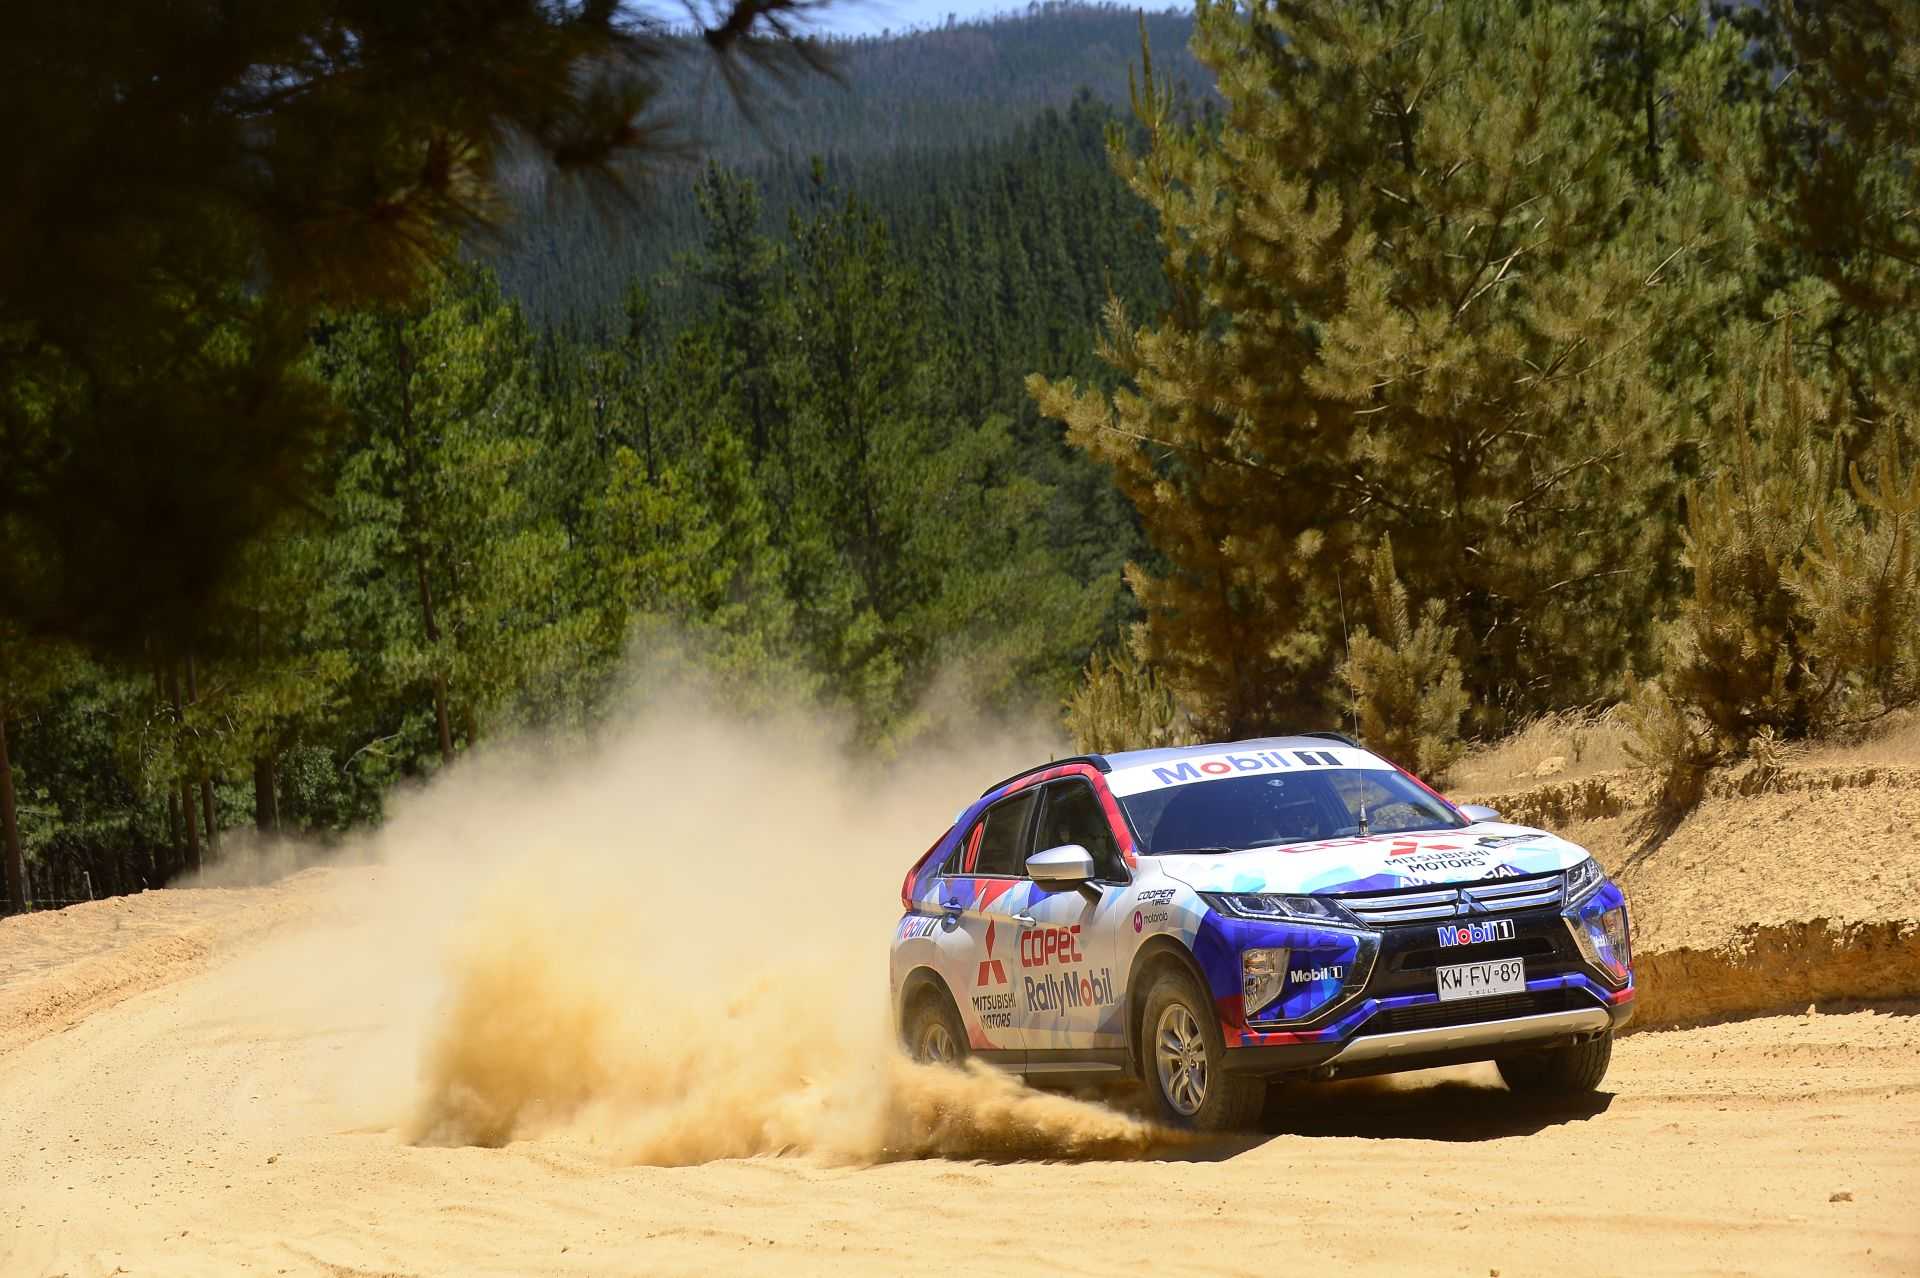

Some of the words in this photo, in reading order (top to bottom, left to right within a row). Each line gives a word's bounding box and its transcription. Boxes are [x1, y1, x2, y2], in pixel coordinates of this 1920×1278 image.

[1152, 752, 1291, 784] Mobil
[1384, 849, 1491, 867] MITSUBISHI
[1407, 857, 1487, 873] MOTORS
[1137, 888, 1177, 901] COOPER
[1437, 923, 1496, 948] Mobil
[1021, 924, 1083, 968] COPEC
[1290, 967, 1328, 983] Mobil
[971, 991, 1017, 1012] MITSUBISHI
